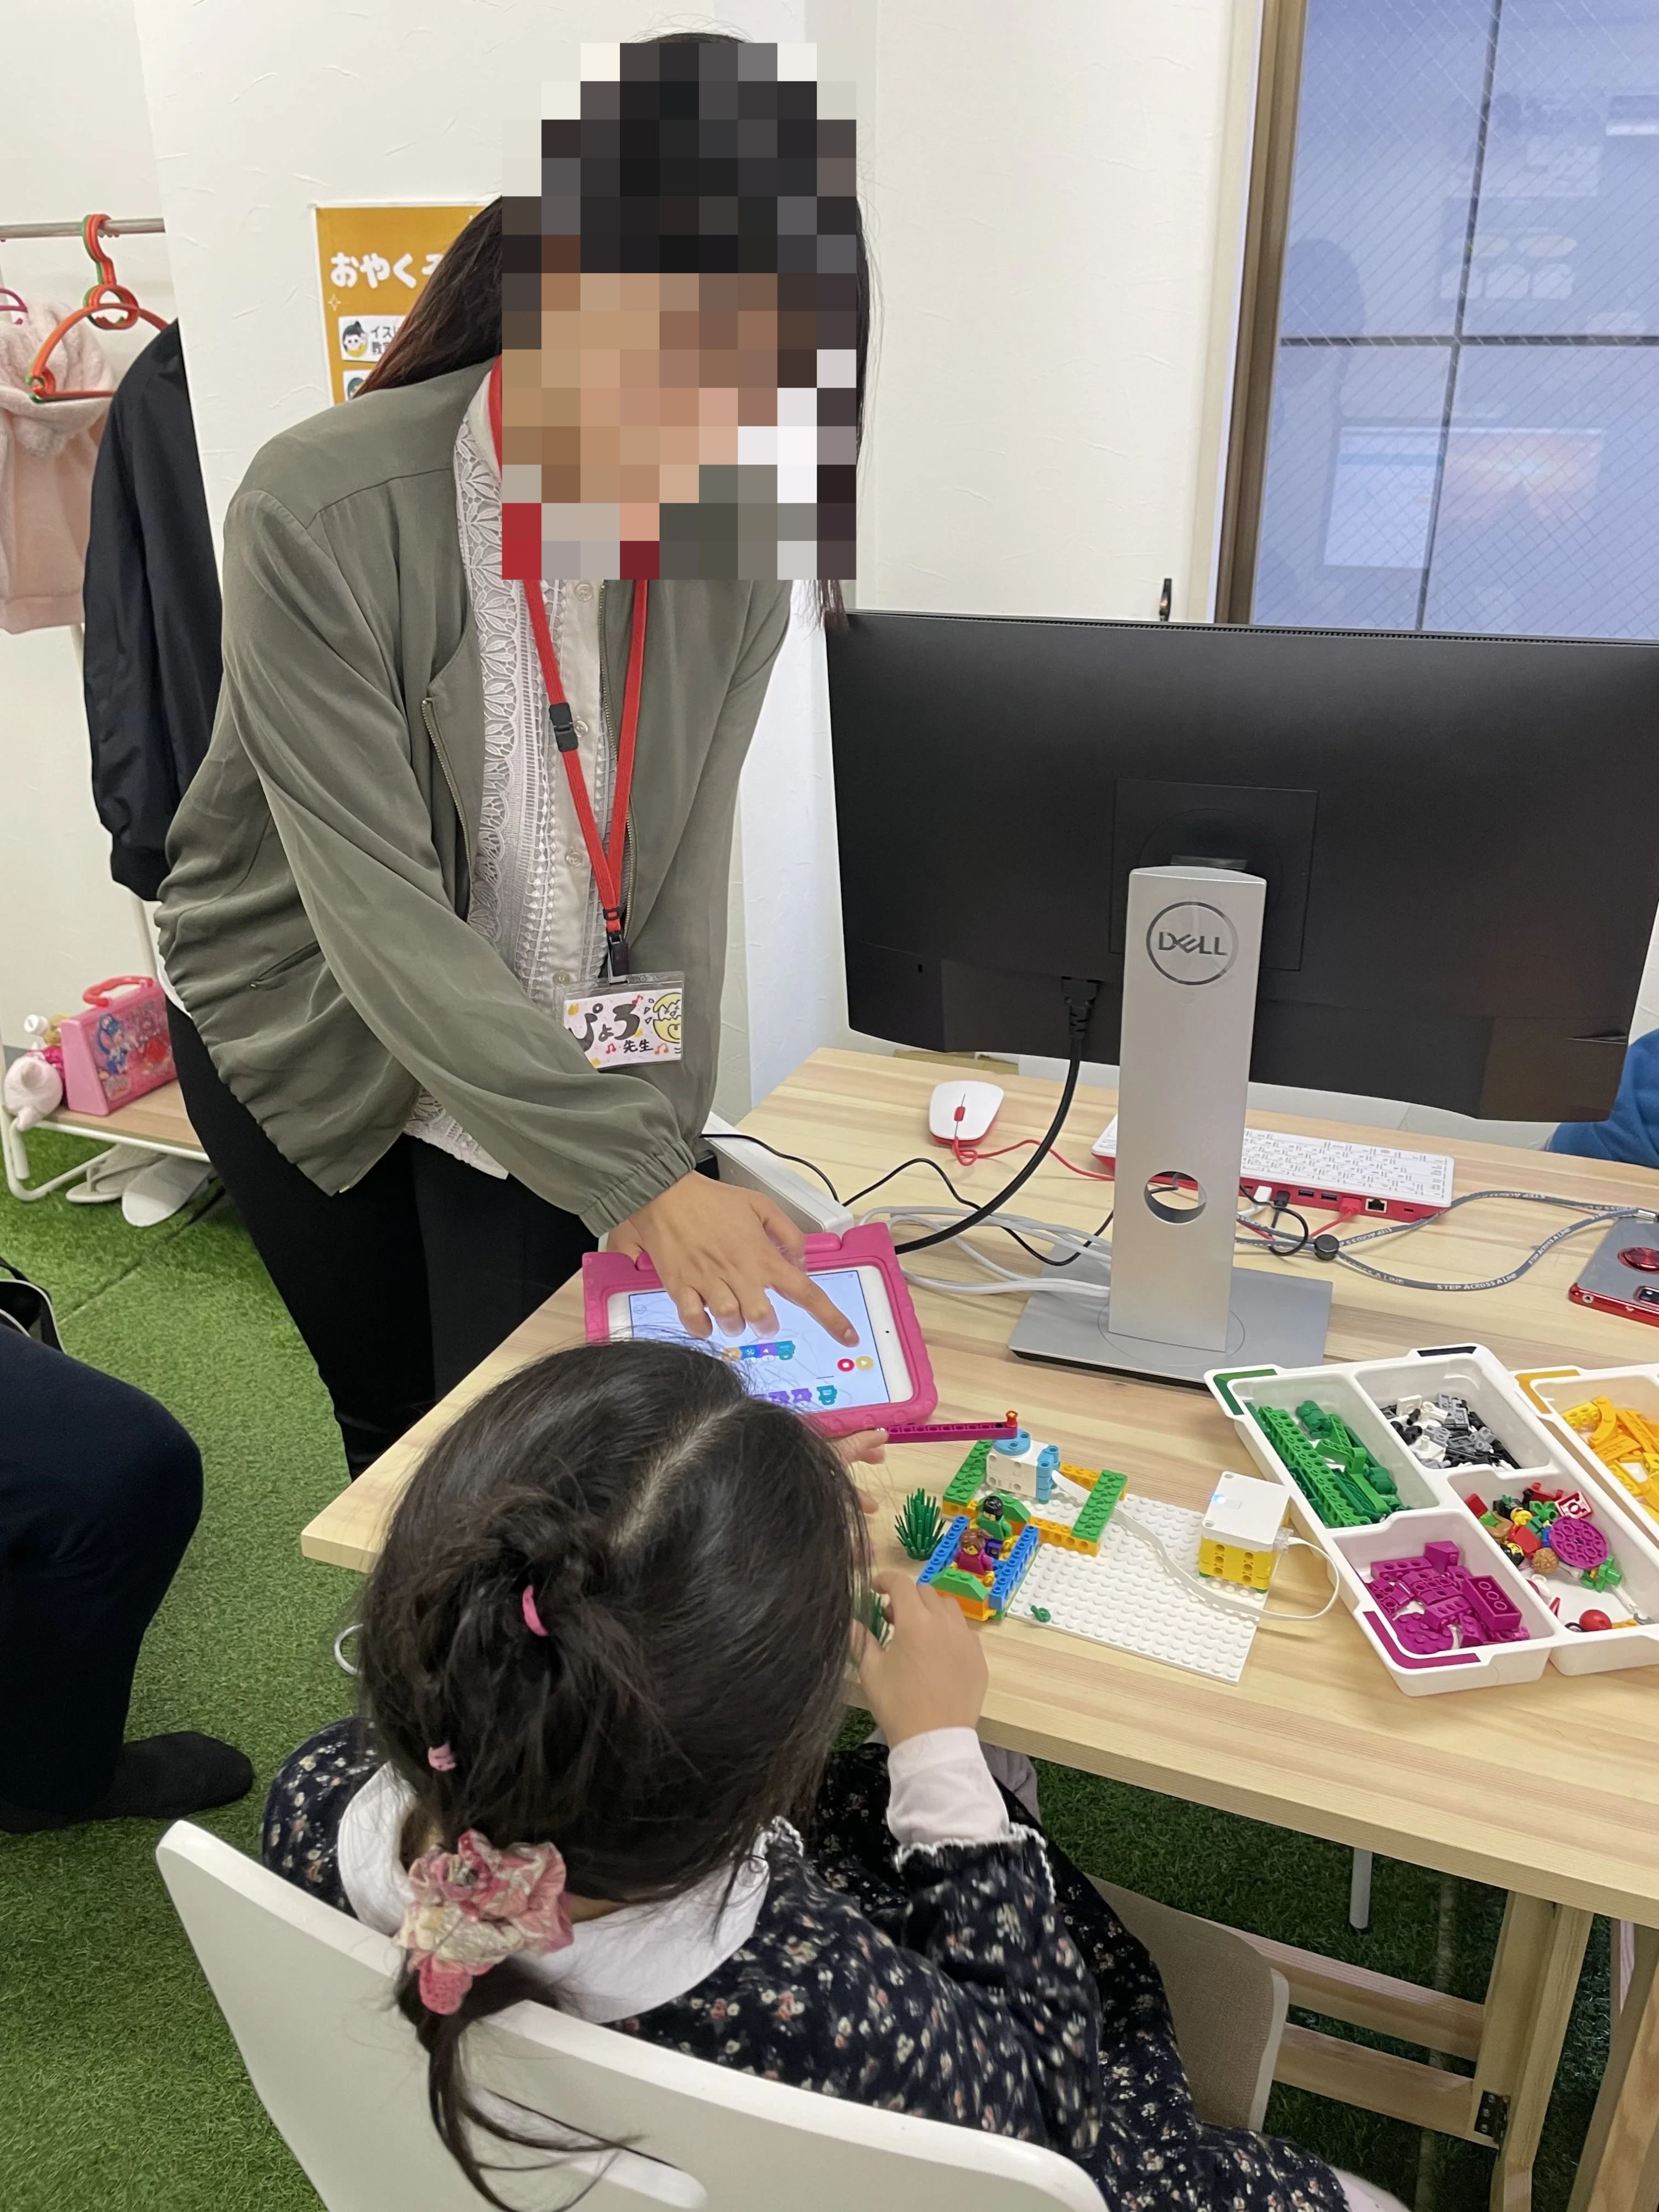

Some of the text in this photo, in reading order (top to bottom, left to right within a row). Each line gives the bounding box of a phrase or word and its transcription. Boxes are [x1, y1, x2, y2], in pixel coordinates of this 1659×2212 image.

[1159, 931, 1228, 956] DELL
[623, 1039, 654, 1053] 先生
[1345, 1232, 1375, 1245] ACROSS
[1376, 1227, 1393, 1237] STEP
[1464, 1281, 1496, 1290] ACROSS
